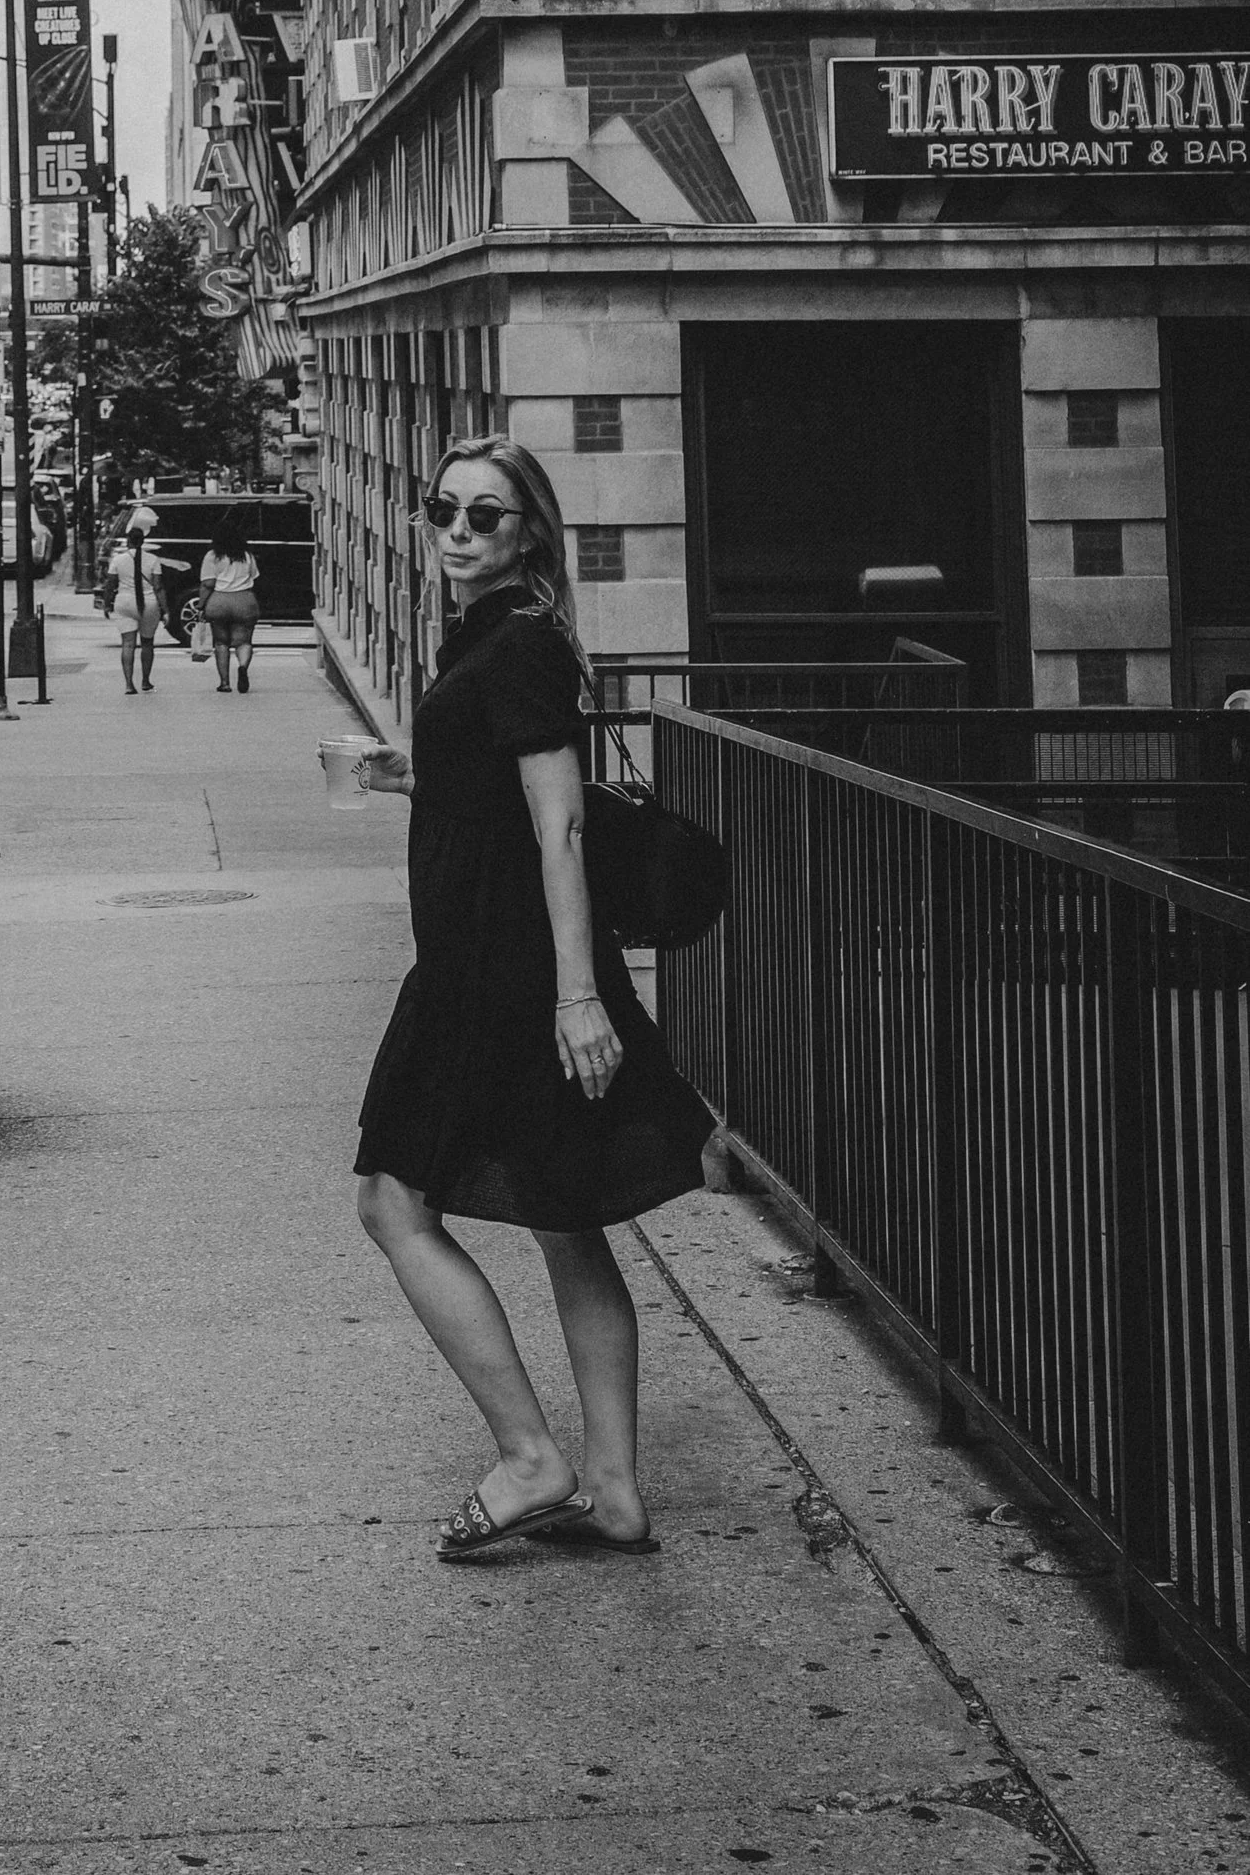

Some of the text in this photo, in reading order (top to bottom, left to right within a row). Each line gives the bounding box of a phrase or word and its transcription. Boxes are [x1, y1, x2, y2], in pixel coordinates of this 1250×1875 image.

[877, 65, 1064, 136] HARRY
[927, 139, 1248, 169] RESTAURANT & BAR
[34, 301, 67, 315] HARRY
[70, 299, 101, 314] CARAY
